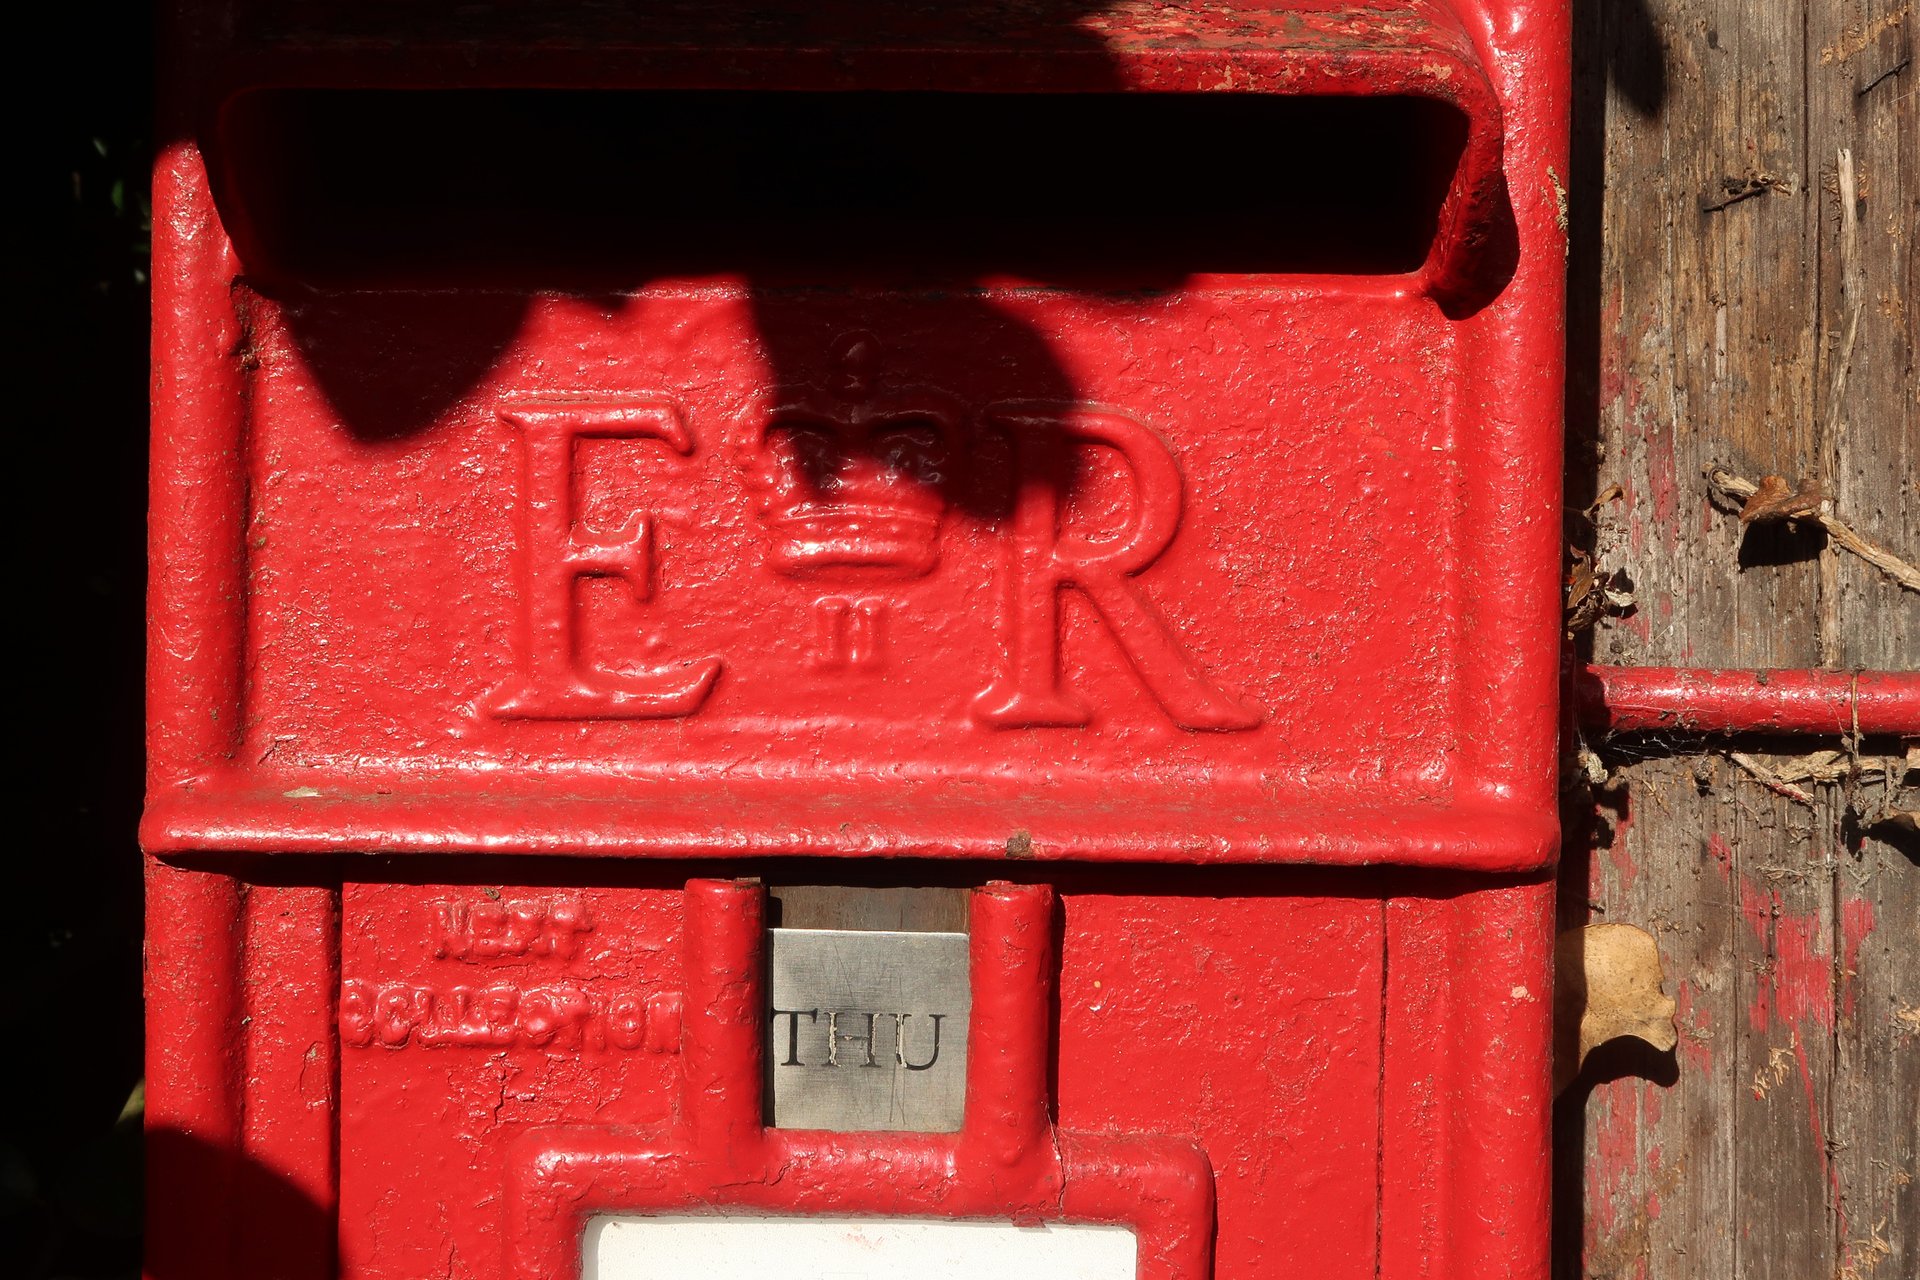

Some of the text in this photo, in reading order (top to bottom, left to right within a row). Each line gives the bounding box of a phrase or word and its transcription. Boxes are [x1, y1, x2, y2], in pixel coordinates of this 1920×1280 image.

[487, 396, 1262, 732] E R
[770, 1007, 946, 1071] THU
